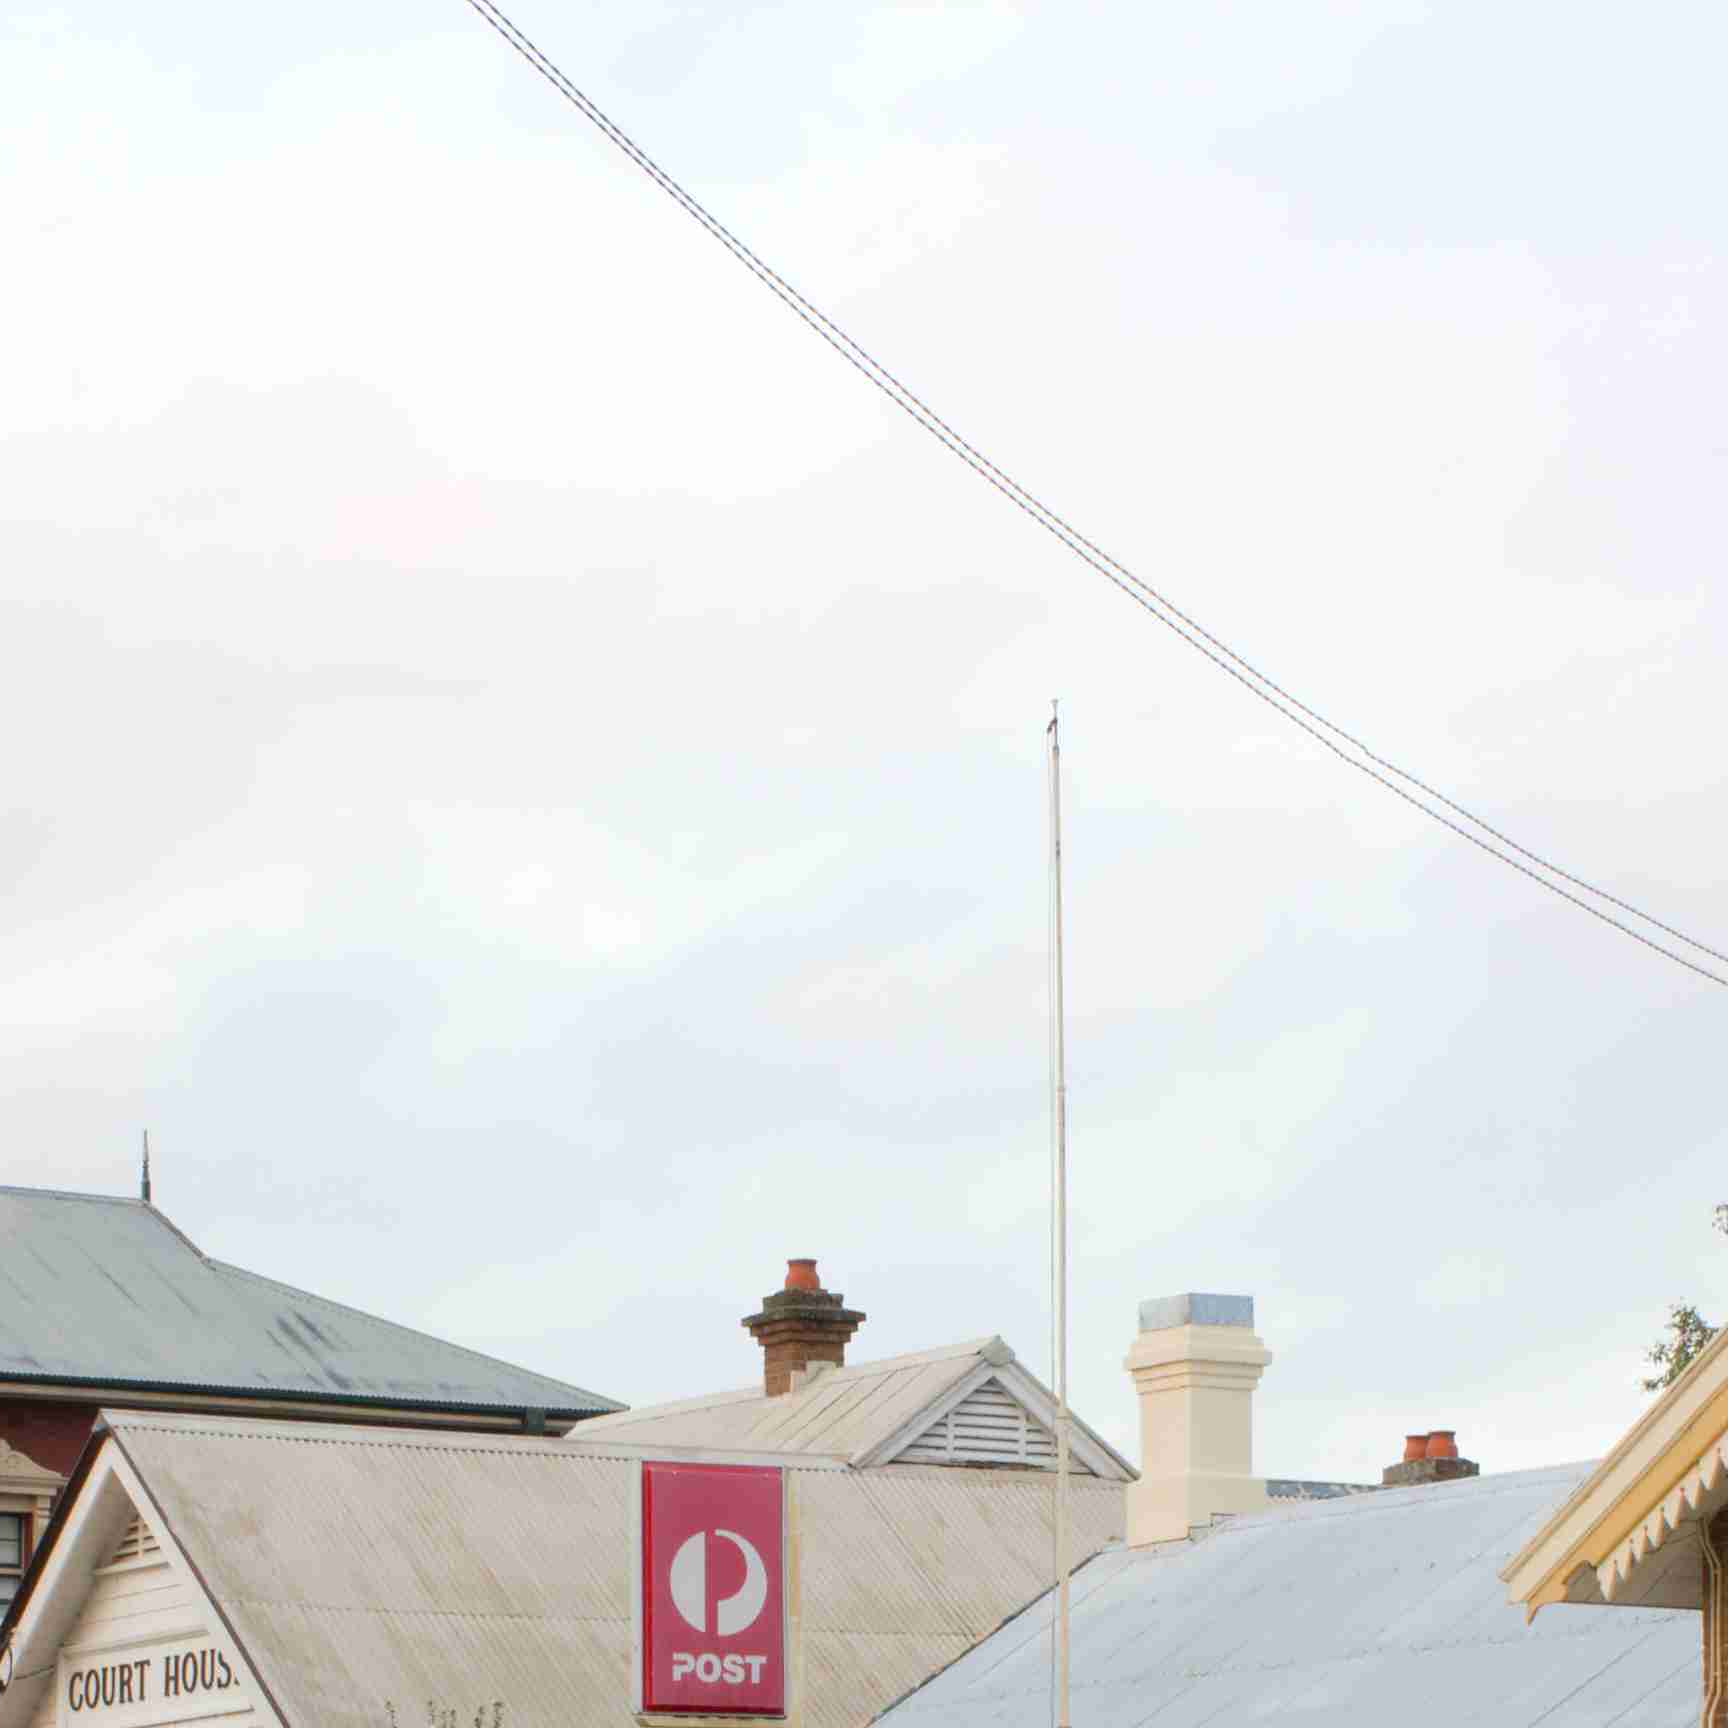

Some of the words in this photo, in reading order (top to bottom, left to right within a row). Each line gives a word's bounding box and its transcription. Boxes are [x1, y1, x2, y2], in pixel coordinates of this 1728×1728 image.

[68, 1658, 151, 1712] COURT
[164, 1648, 241, 1698] HOUS
[672, 1651, 768, 1685] POST
